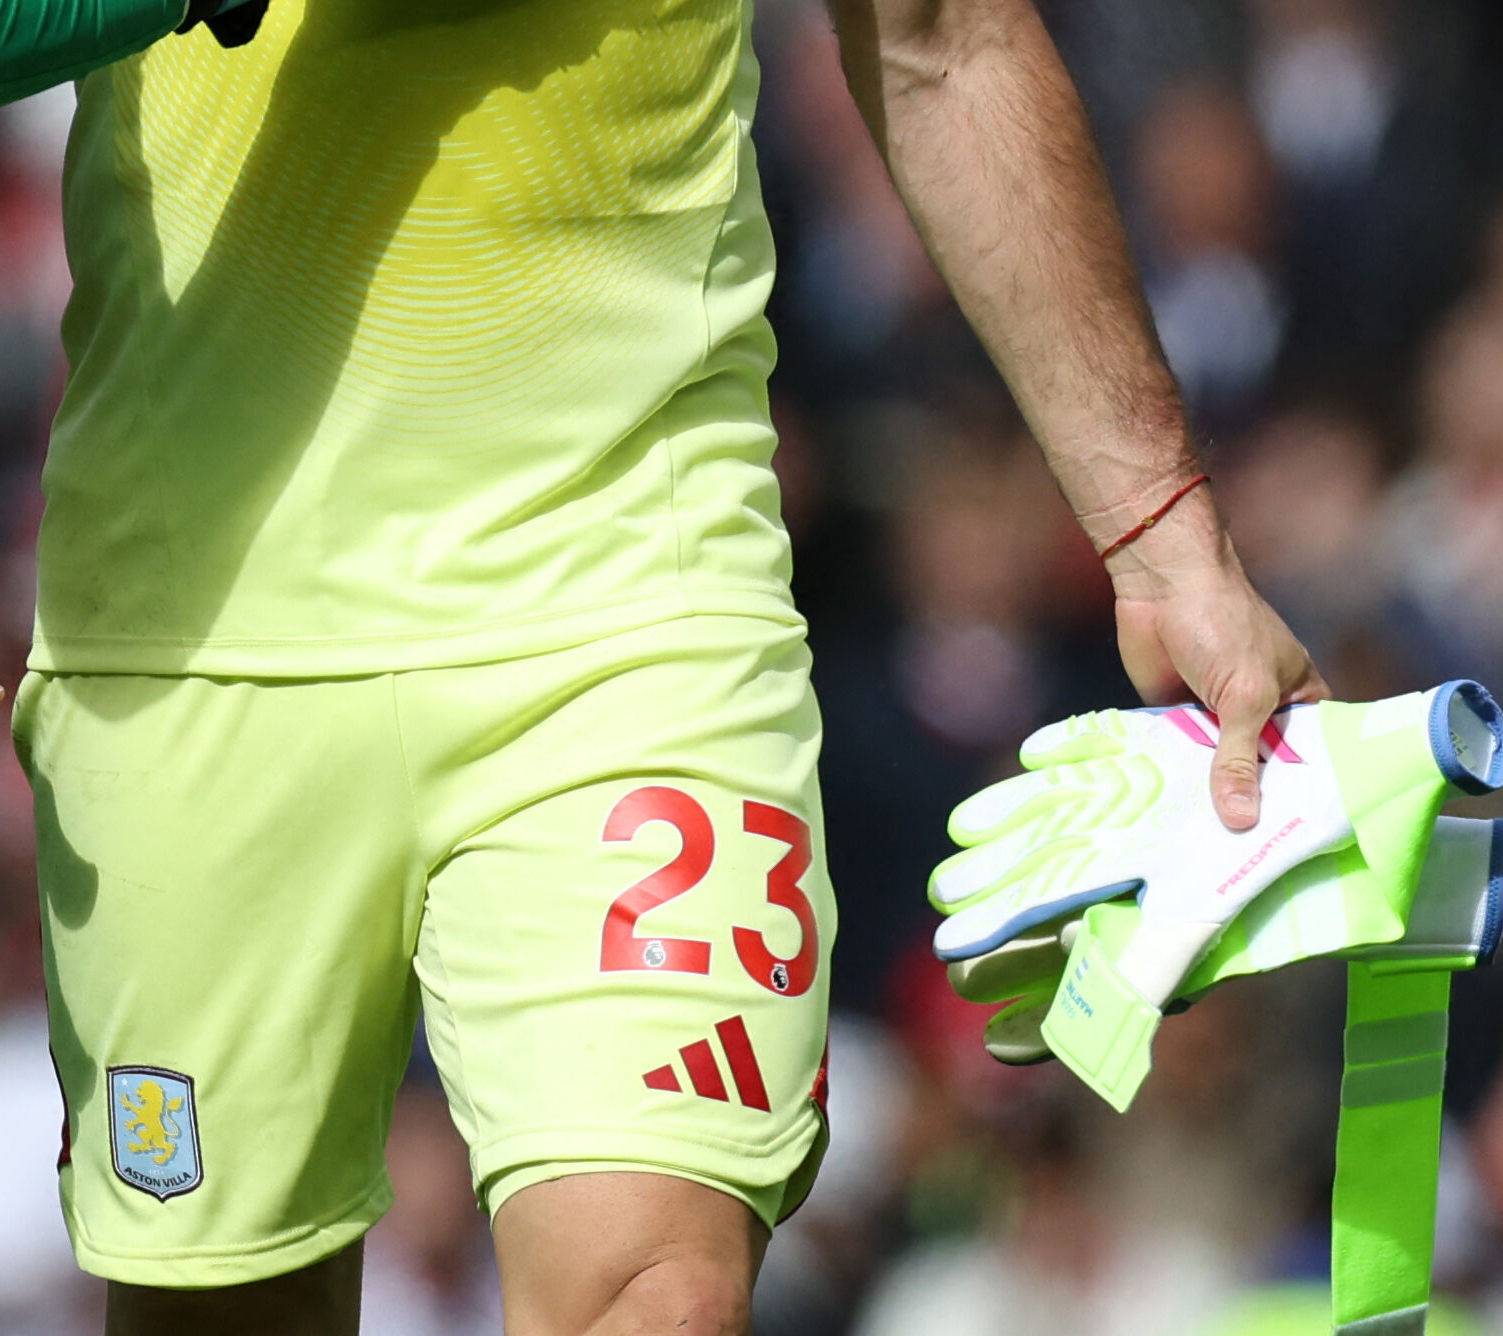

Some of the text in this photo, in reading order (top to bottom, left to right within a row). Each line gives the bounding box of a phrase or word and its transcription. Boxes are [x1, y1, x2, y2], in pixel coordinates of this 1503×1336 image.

[599, 785, 819, 998] 23
[1216, 817, 1307, 896] PREDATOR
[123, 1166, 162, 1188] ASTON
[162, 1171, 193, 1188] VILLA
